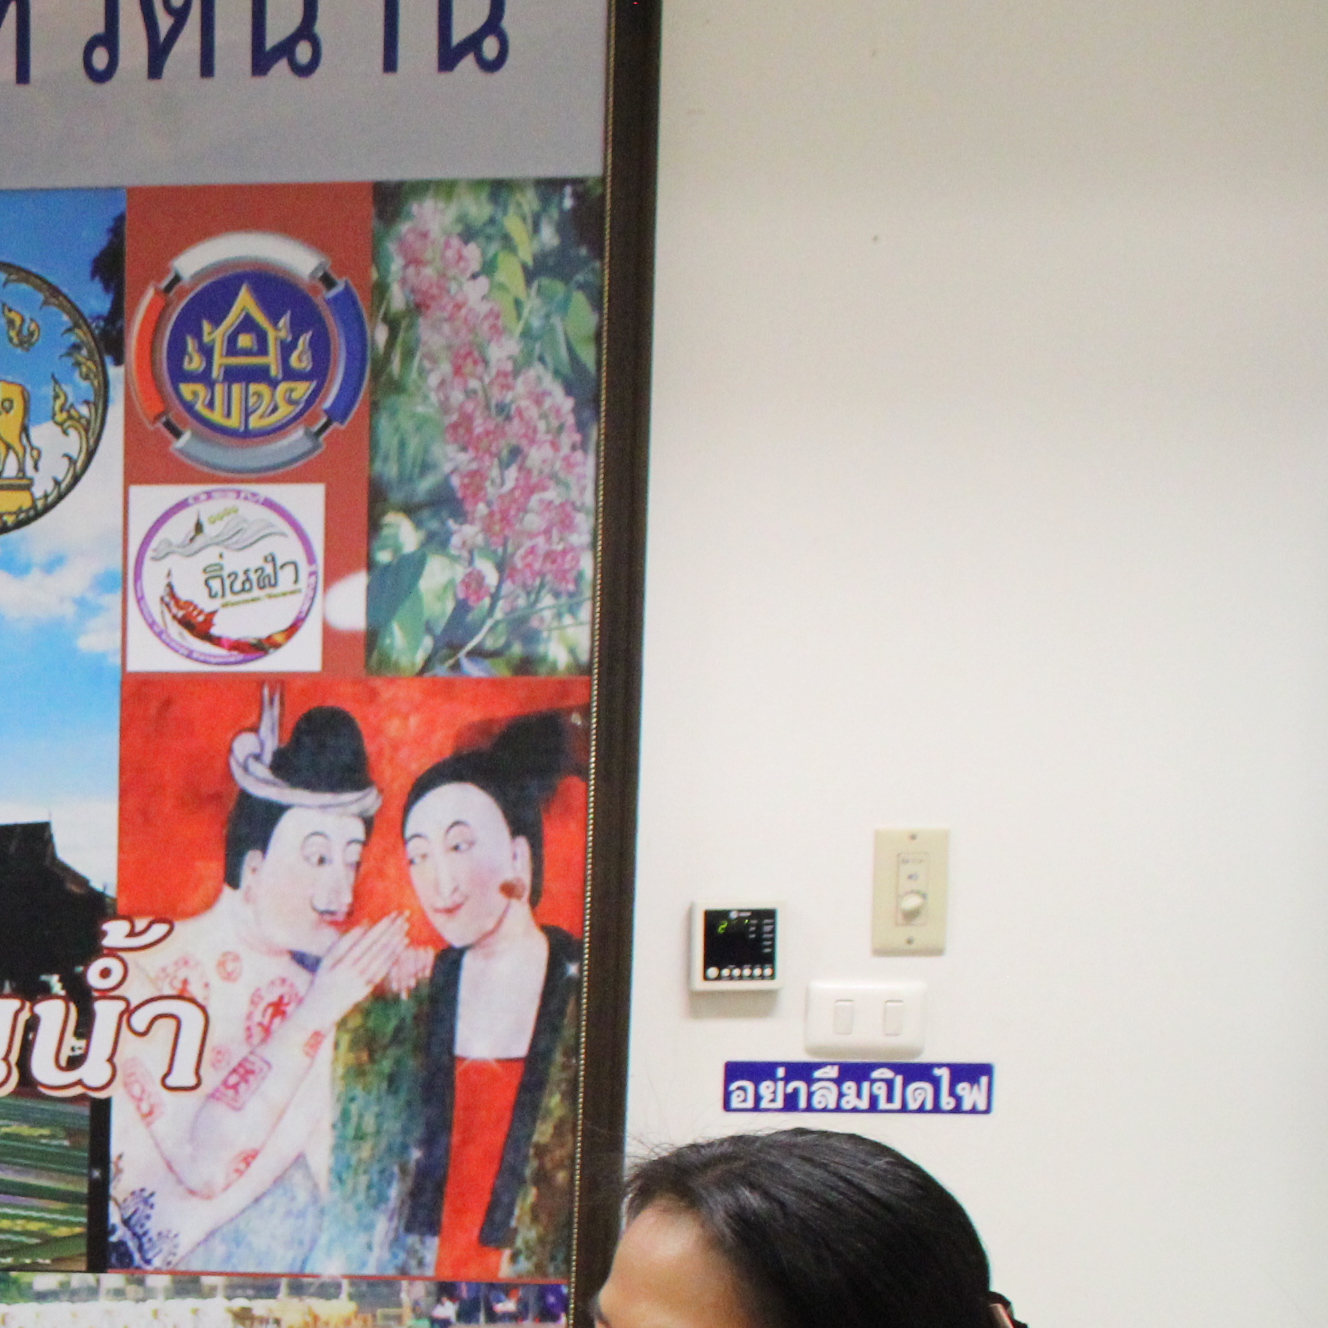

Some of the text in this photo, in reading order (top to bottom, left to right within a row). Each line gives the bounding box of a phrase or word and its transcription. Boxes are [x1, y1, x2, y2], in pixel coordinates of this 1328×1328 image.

[729, 1065, 990, 1111] อย่าลืมปิดไฟ
